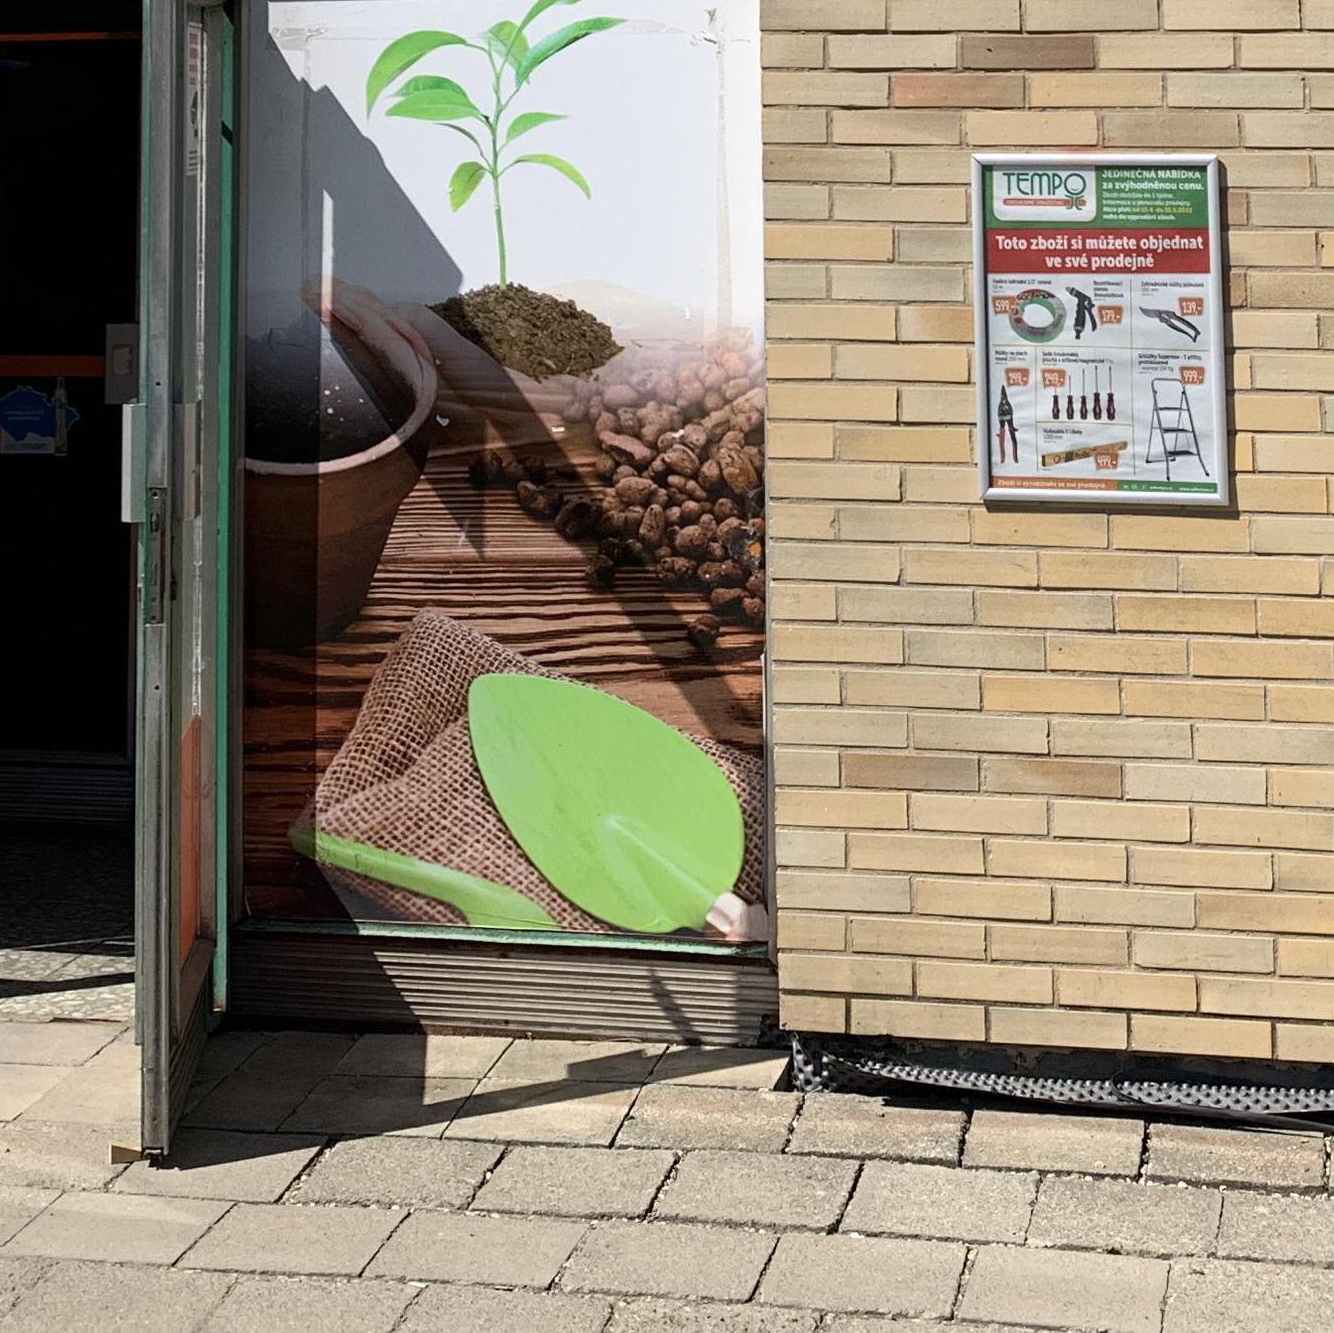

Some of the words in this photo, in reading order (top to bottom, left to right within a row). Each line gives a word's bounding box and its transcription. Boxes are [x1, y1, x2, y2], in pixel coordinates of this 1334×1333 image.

[1101, 168, 1157, 179] JEDINEČNÁ
[1002, 172, 1087, 196] TEMPO
[1101, 182, 1113, 190] za
[1114, 180, 1178, 192] zvýhodněnou
[1178, 182, 1205, 190] cenu.
[995, 235, 1027, 250] Toto
[1030, 234, 1068, 250] zboží
[1071, 235, 1082, 250] si
[1085, 235, 1137, 250] můžete
[1139, 235, 1204, 253] objednat
[1045, 255, 1062, 267] ve
[1065, 254, 1088, 267] své
[1091, 254, 1154, 271] prodejně
